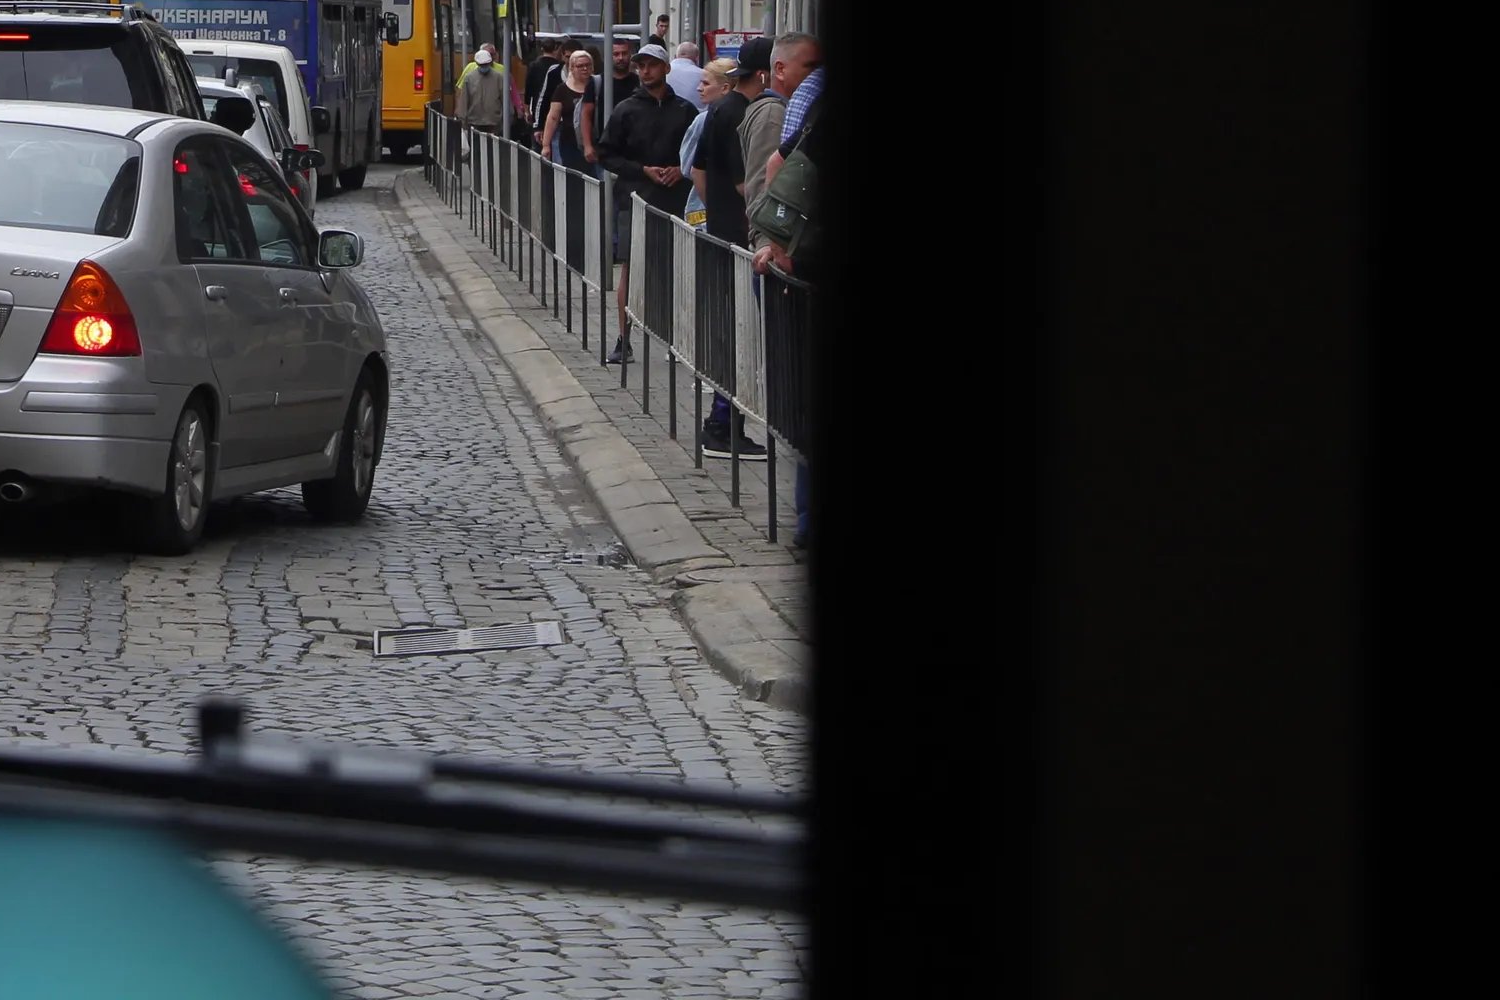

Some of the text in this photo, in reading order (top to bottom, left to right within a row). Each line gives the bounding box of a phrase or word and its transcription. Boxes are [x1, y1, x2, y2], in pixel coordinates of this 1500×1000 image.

[151, 8, 268, 25] ОКЕАНАРІУМ
[195, 28, 261, 41] Шевченка
[278, 29, 286, 41] 8
